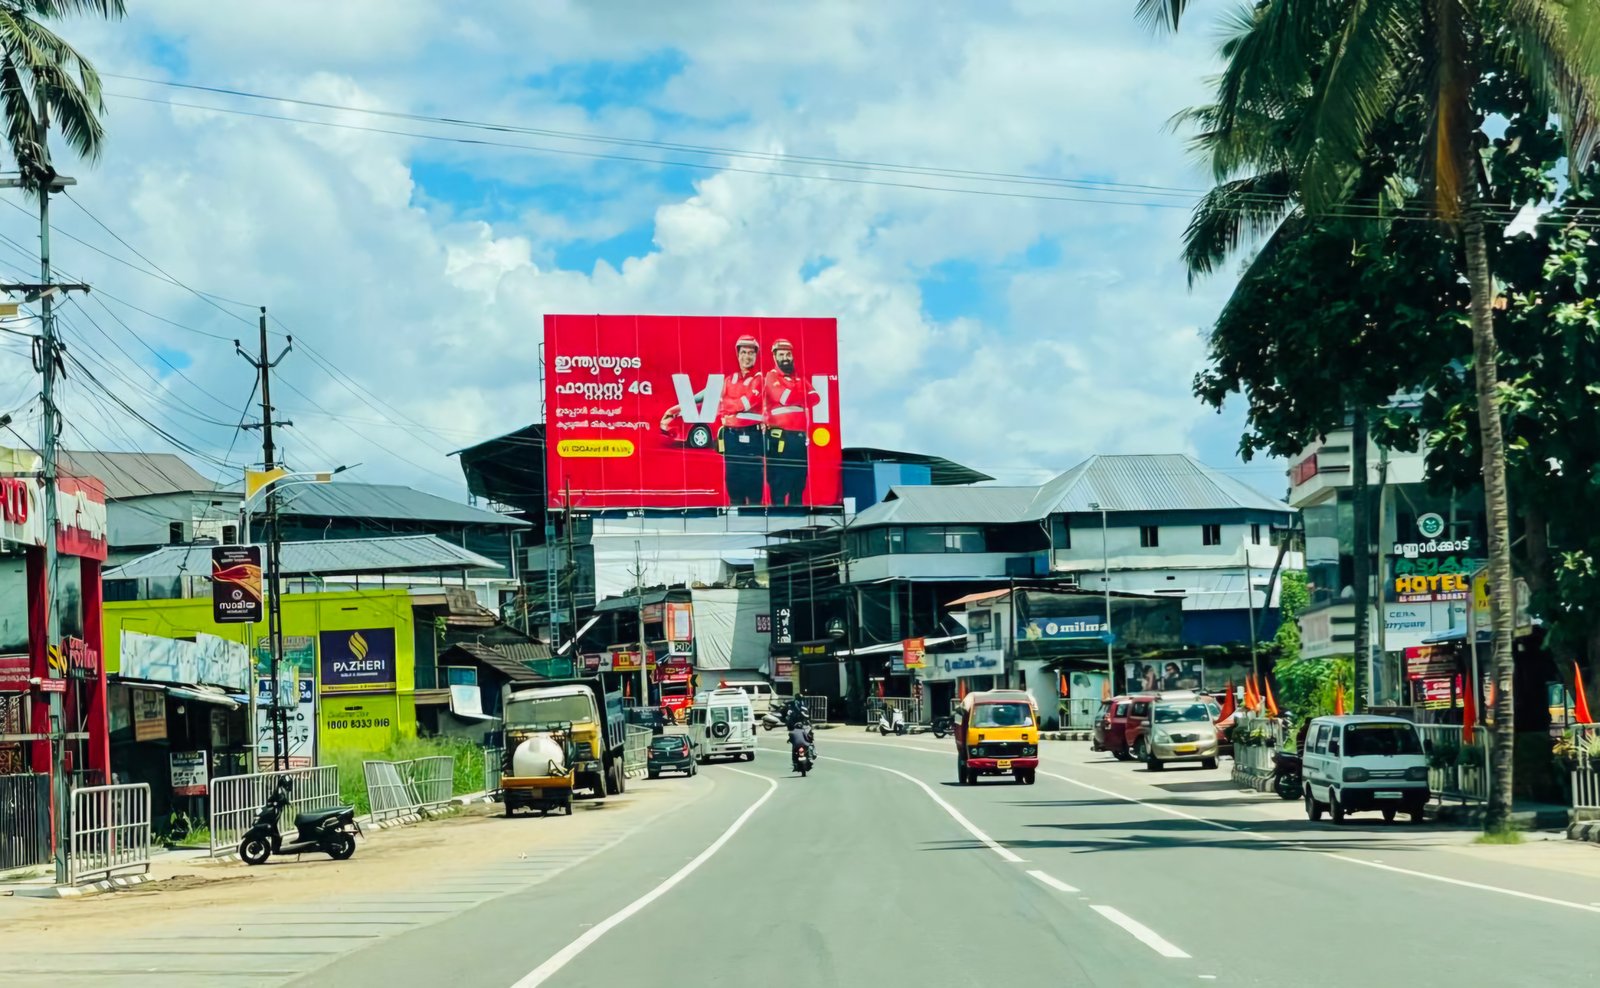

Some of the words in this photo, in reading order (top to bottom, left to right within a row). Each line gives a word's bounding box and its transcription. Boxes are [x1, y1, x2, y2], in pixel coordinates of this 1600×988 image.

[555, 356, 642, 376] ഇന്ത്യയുടെ
[628, 380, 653, 395] 4G
[1395, 574, 1469, 593] HOTEL
[1059, 623, 1108, 633] milma
[333, 659, 385, 673] PAZHERI
